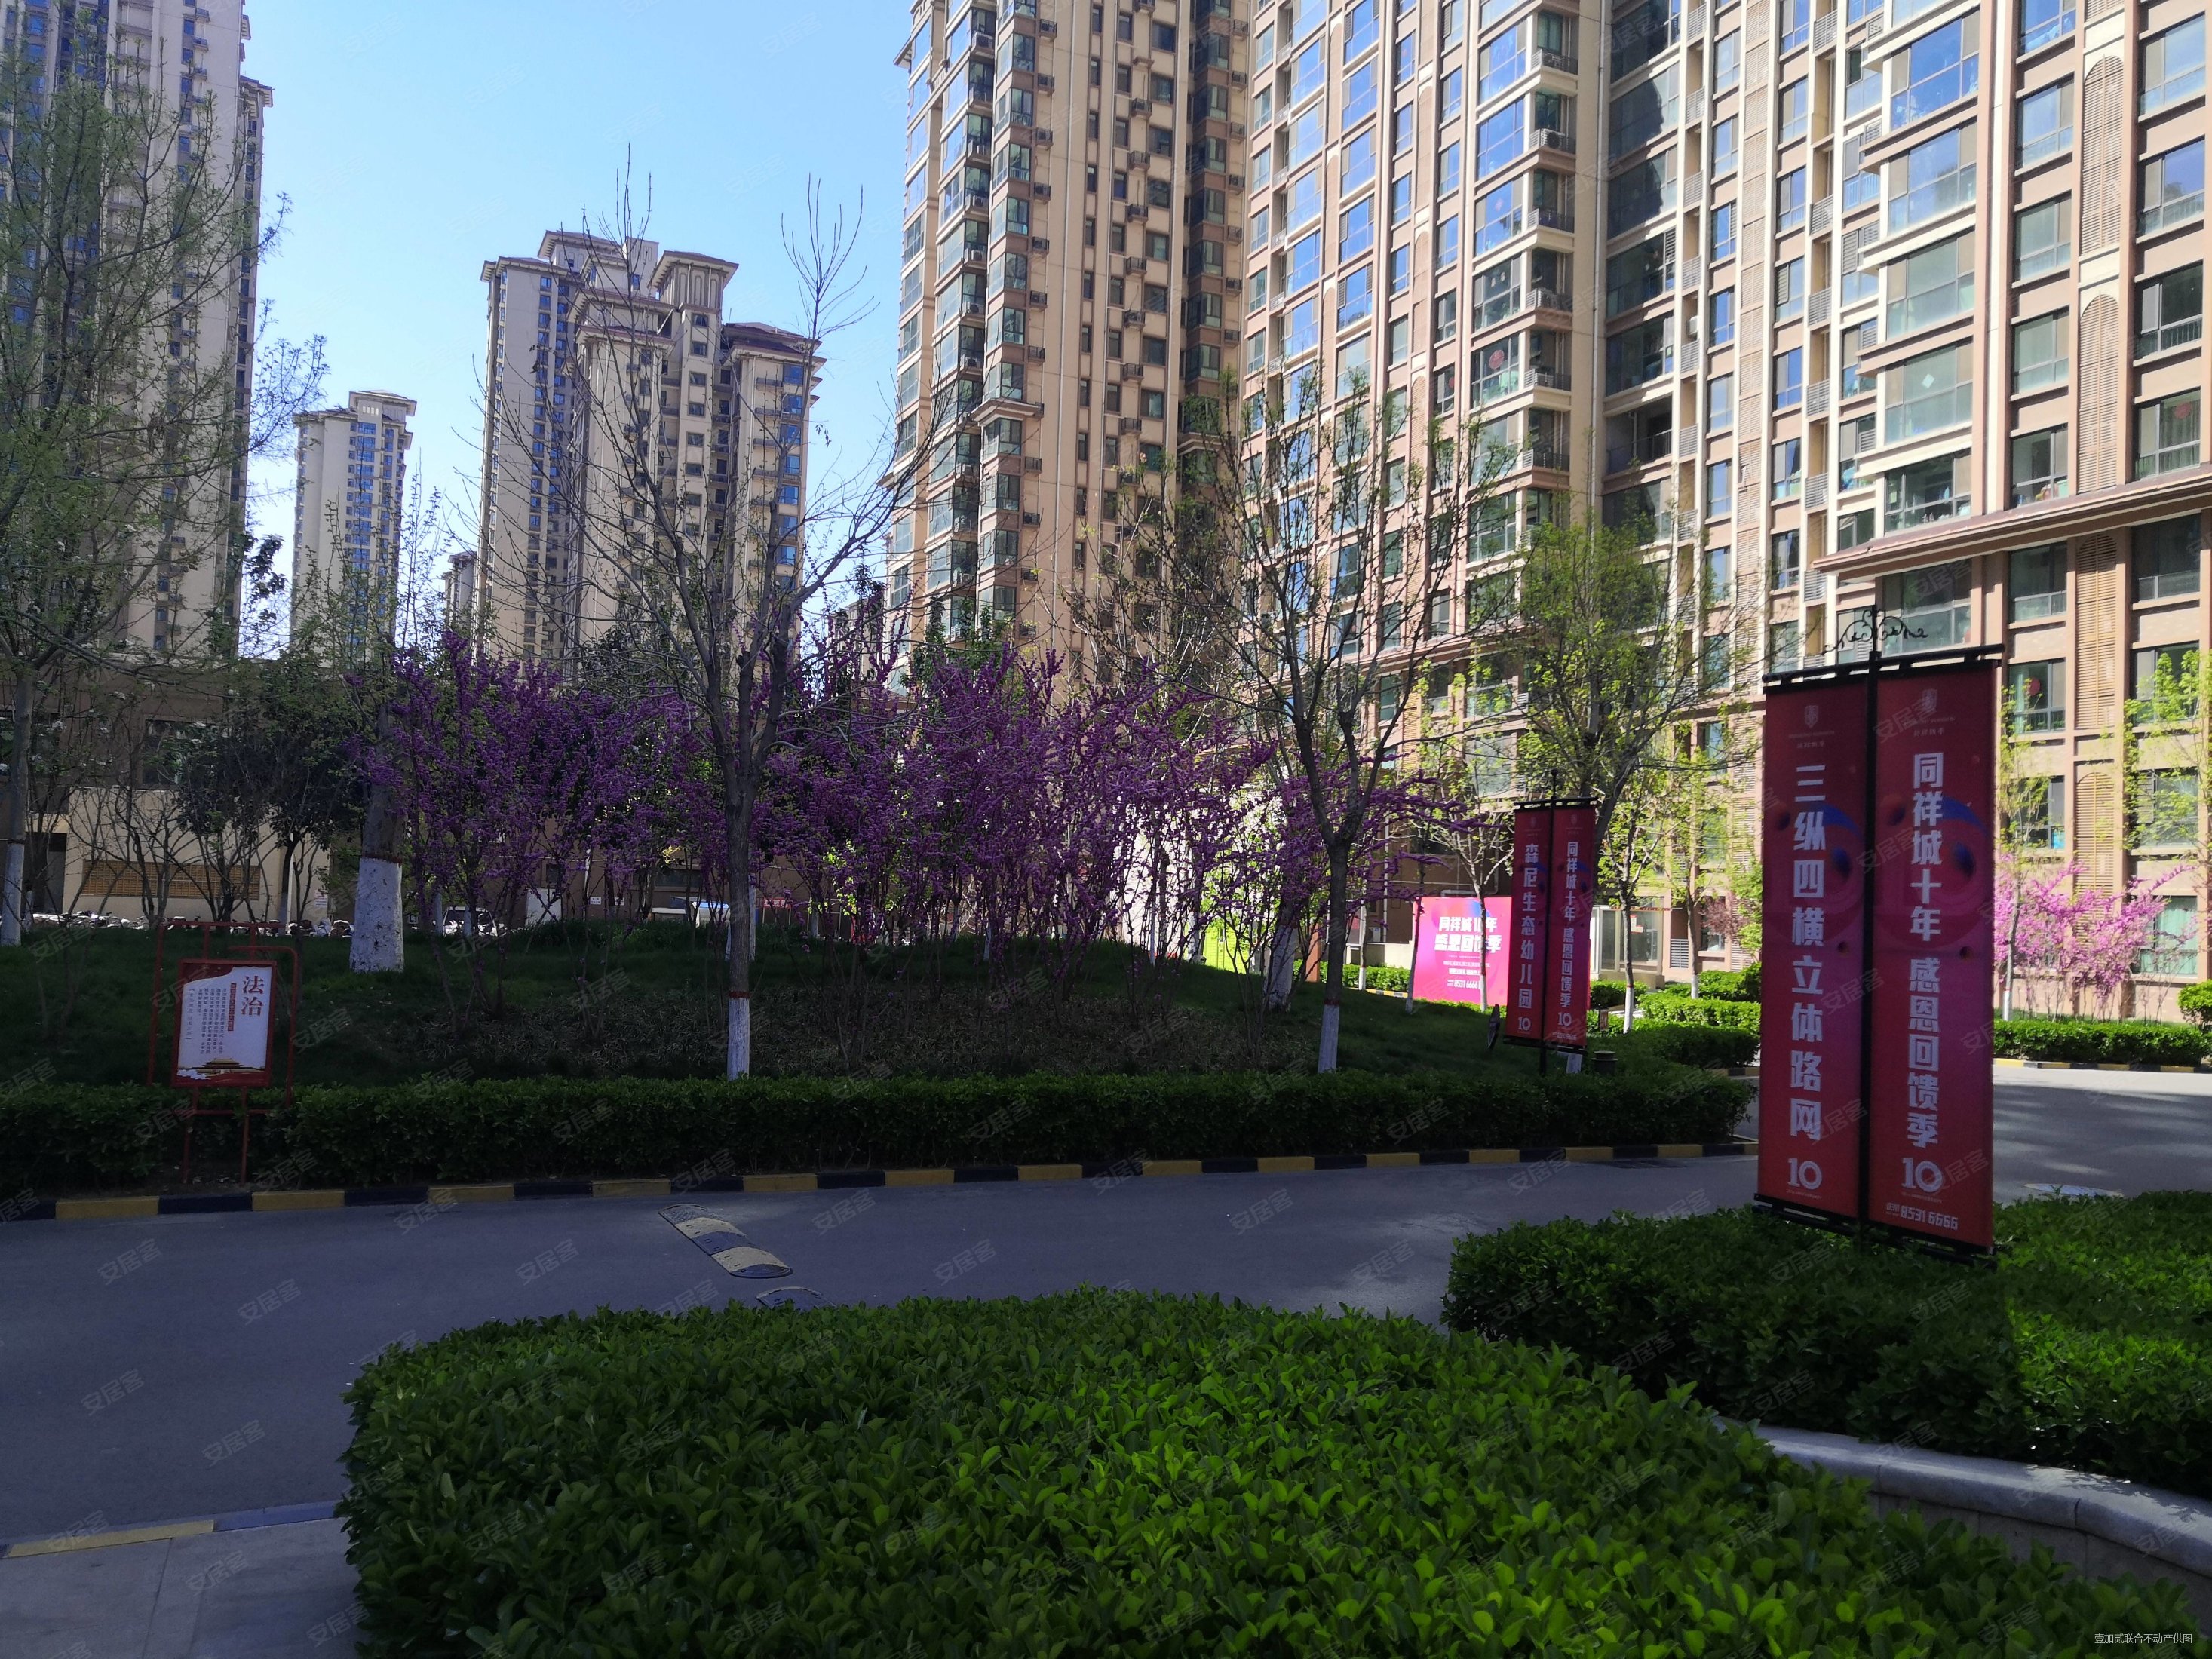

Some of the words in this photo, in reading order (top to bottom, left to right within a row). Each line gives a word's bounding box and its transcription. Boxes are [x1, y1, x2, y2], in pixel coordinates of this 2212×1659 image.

[1910, 752, 1944, 942] 同祥城十年
[1564, 841, 1578, 921] 同祥城十年
[1560, 928, 1575, 1008] 感恩回馈季
[1790, 765, 1826, 1141] 三纵四横立体路网
[241, 975, 265, 1016] 法治
[1517, 1017, 1531, 1031] 10
[1557, 1012, 1572, 1026] 10
[1907, 957, 1940, 1148] 感恩回馈季
[1787, 1158, 1822, 1190] 10
[1901, 1158, 1943, 1191] 10
[1901, 1206, 1925, 1222] 8531
[1928, 1211, 1958, 1231] 6666
